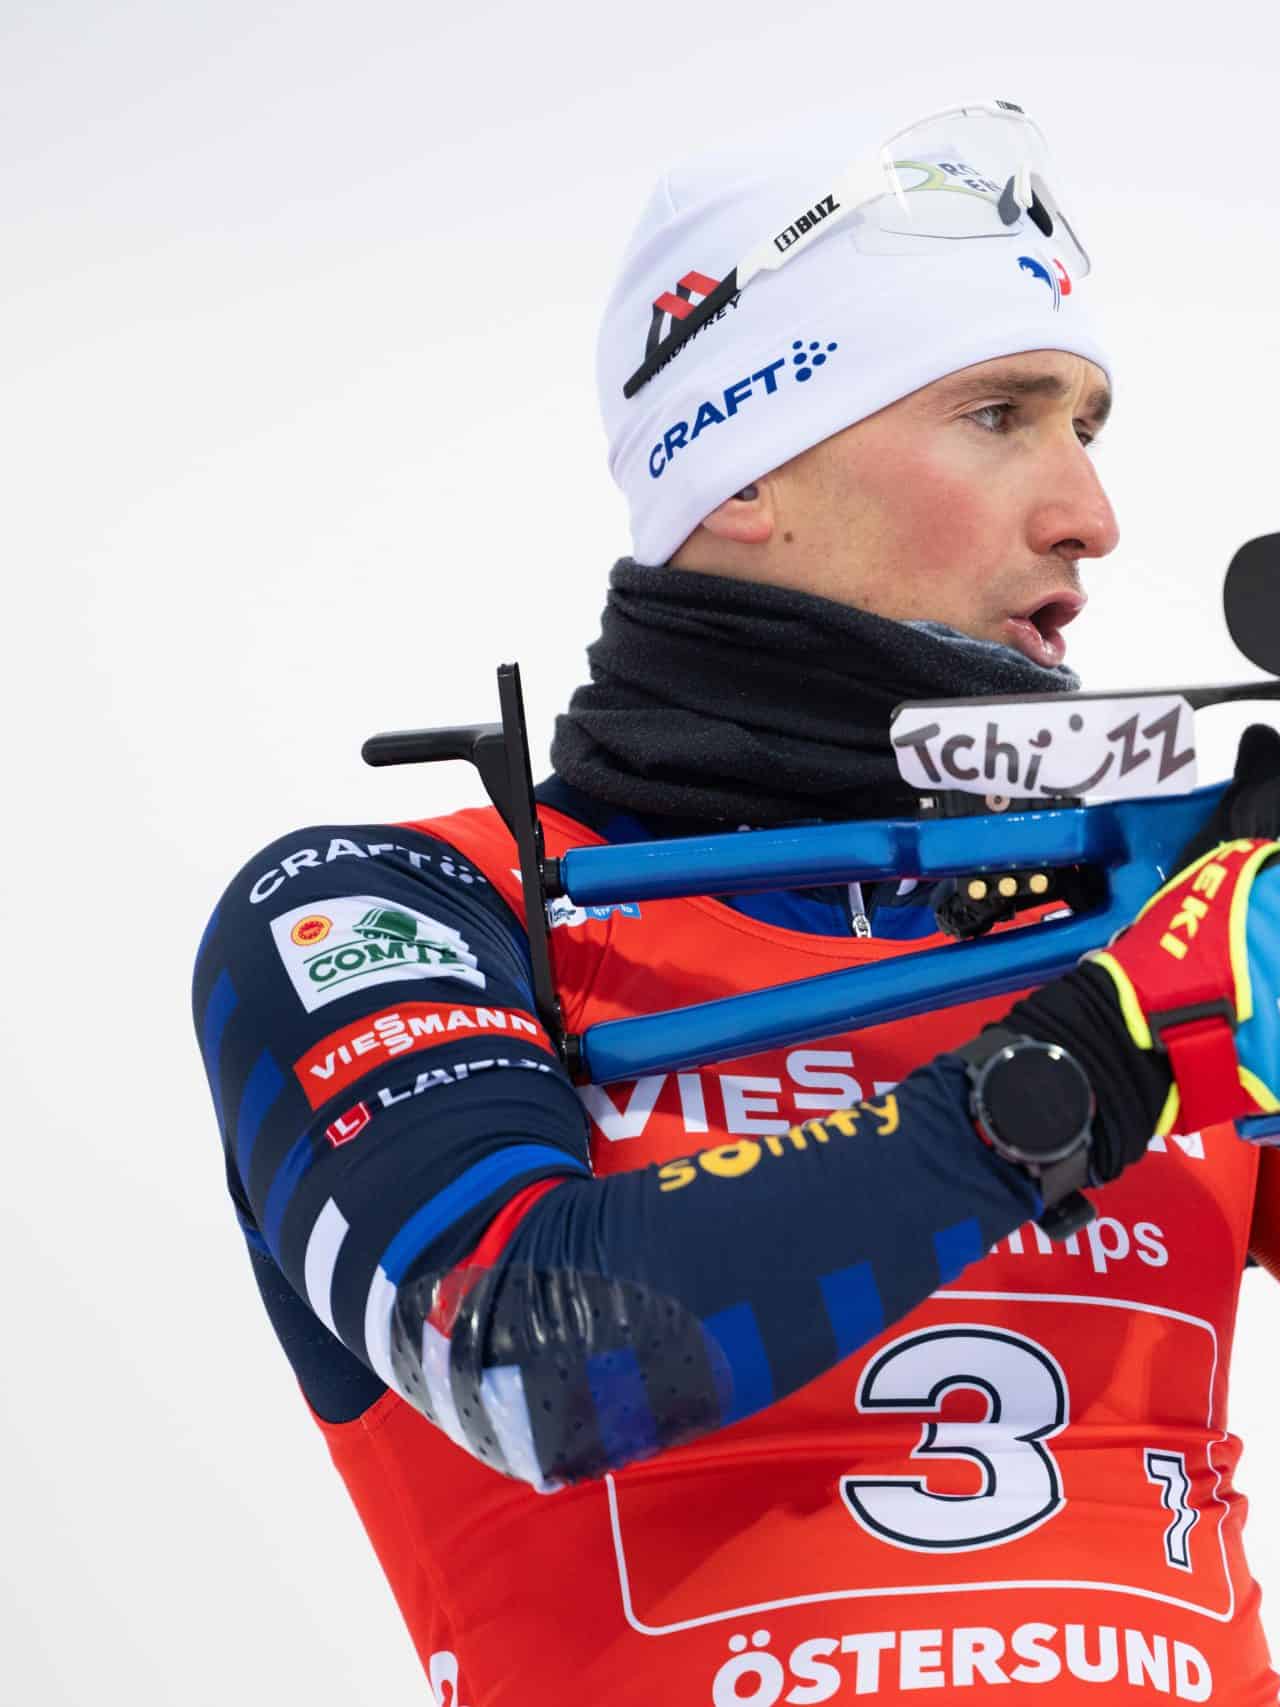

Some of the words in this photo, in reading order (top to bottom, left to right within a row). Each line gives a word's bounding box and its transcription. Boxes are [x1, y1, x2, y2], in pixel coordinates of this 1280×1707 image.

[794, 193, 841, 235] BLIZ
[649, 357, 785, 479] CRAFT
[309, 1007, 538, 1081] VIESSMANN
[840, 1323, 1070, 1553] 3
[712, 1622, 1213, 1707] ÖSTERSUND
